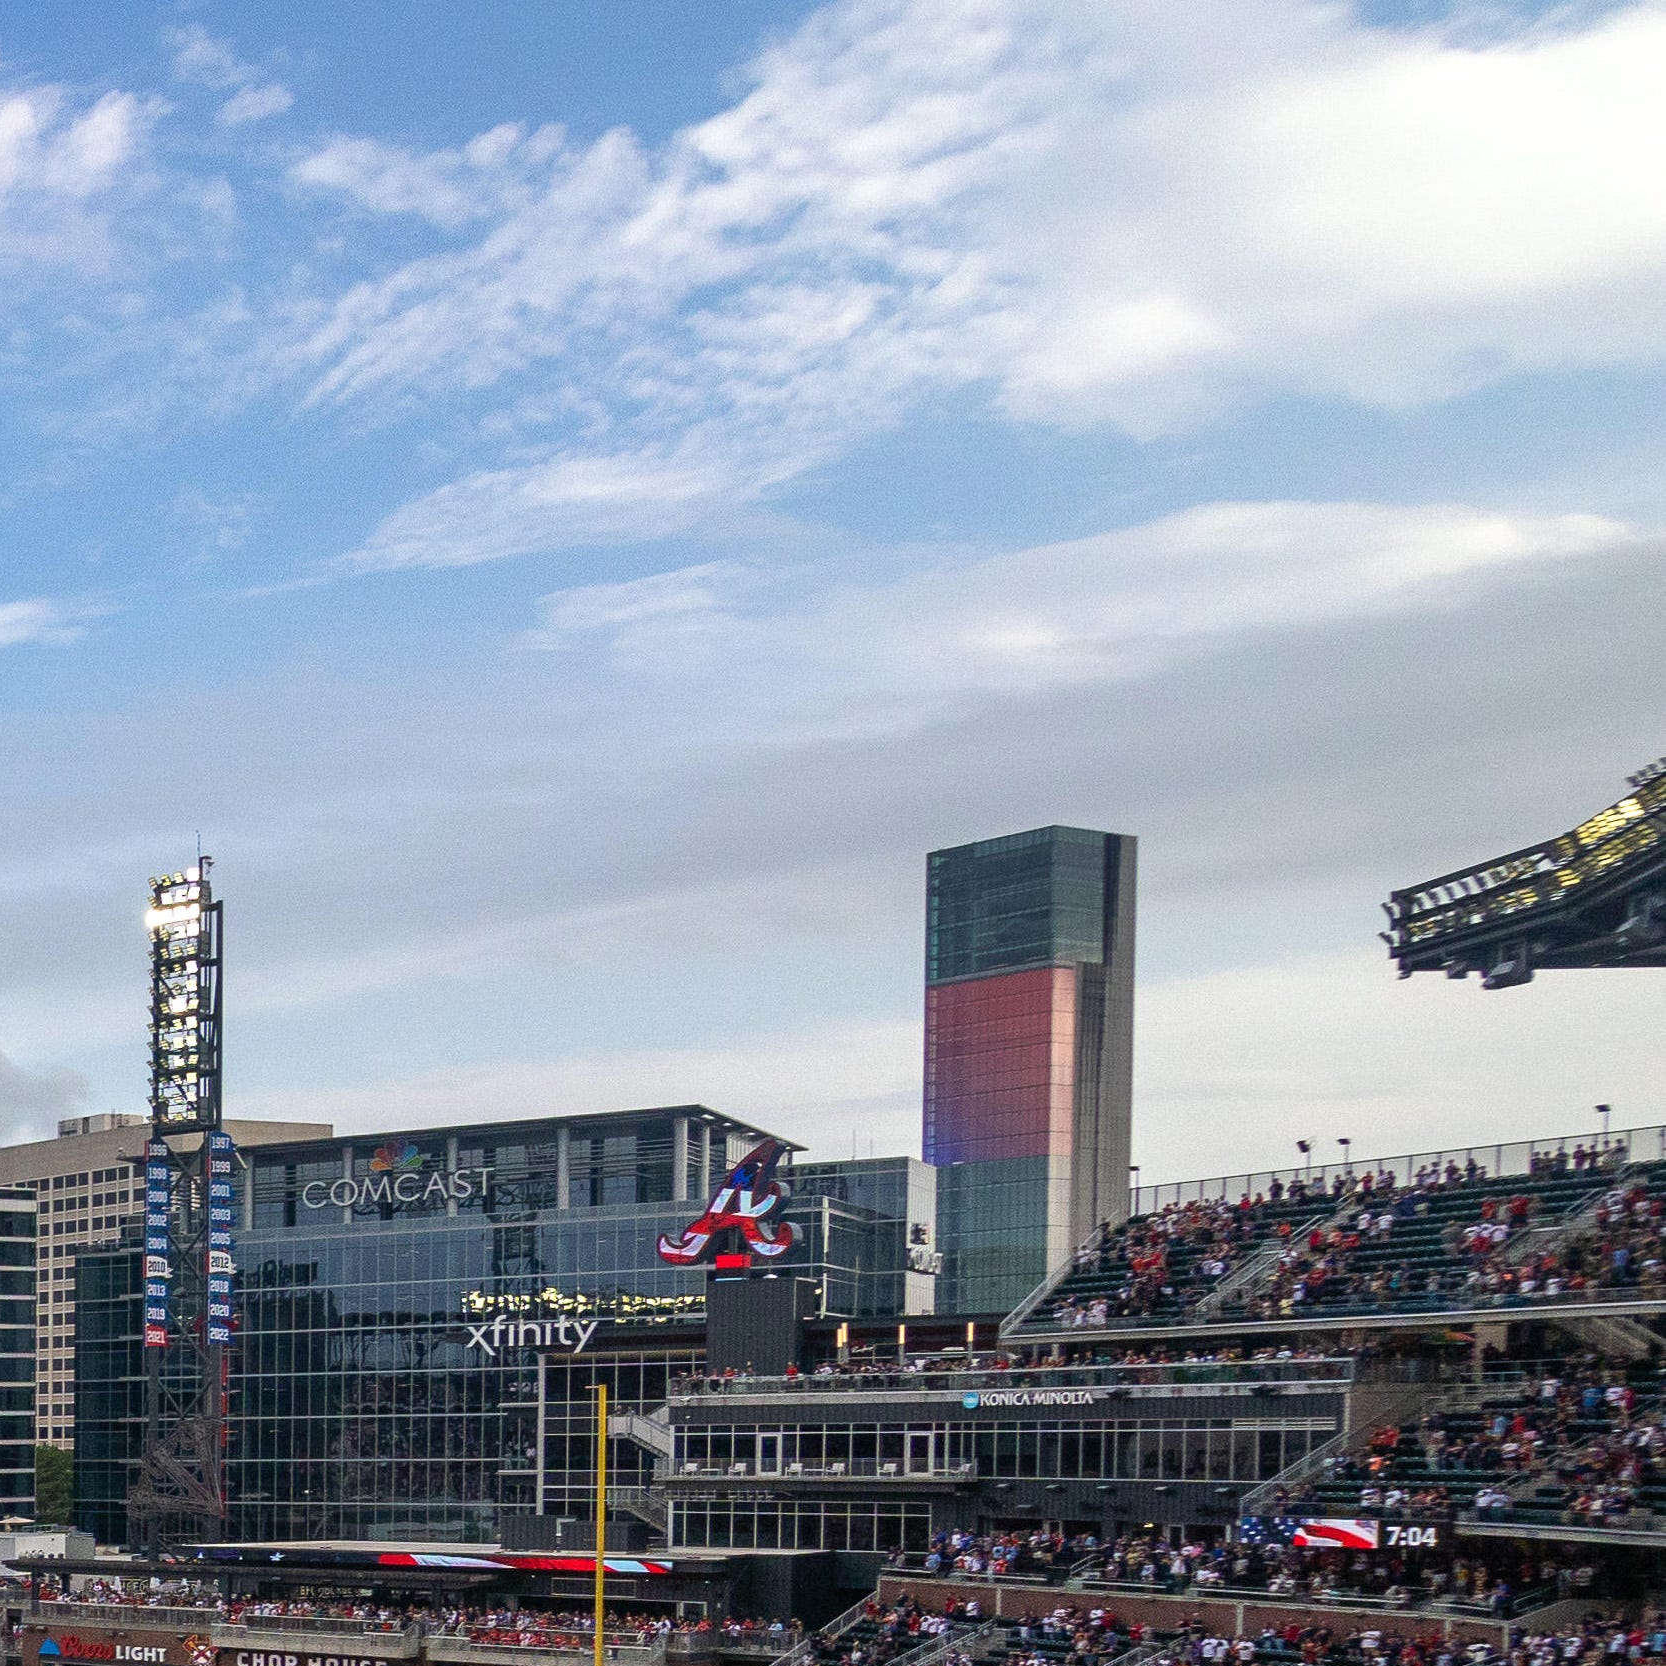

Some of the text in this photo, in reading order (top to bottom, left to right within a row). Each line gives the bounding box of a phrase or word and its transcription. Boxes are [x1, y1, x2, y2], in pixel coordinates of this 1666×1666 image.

[302, 1168, 495, 1209] COMCAST
[148, 1261, 166, 1272] 2010
[211, 1256, 229, 1268] 2012
[147, 1284, 166, 1296] 2013
[147, 1331, 165, 1343] 2021
[467, 1314, 598, 1356] xfinity
[980, 1392, 1093, 1406] KONICA MINOLTA
[1386, 1526, 1438, 1546] 7:04
[115, 1645, 167, 1663] LIGHT
